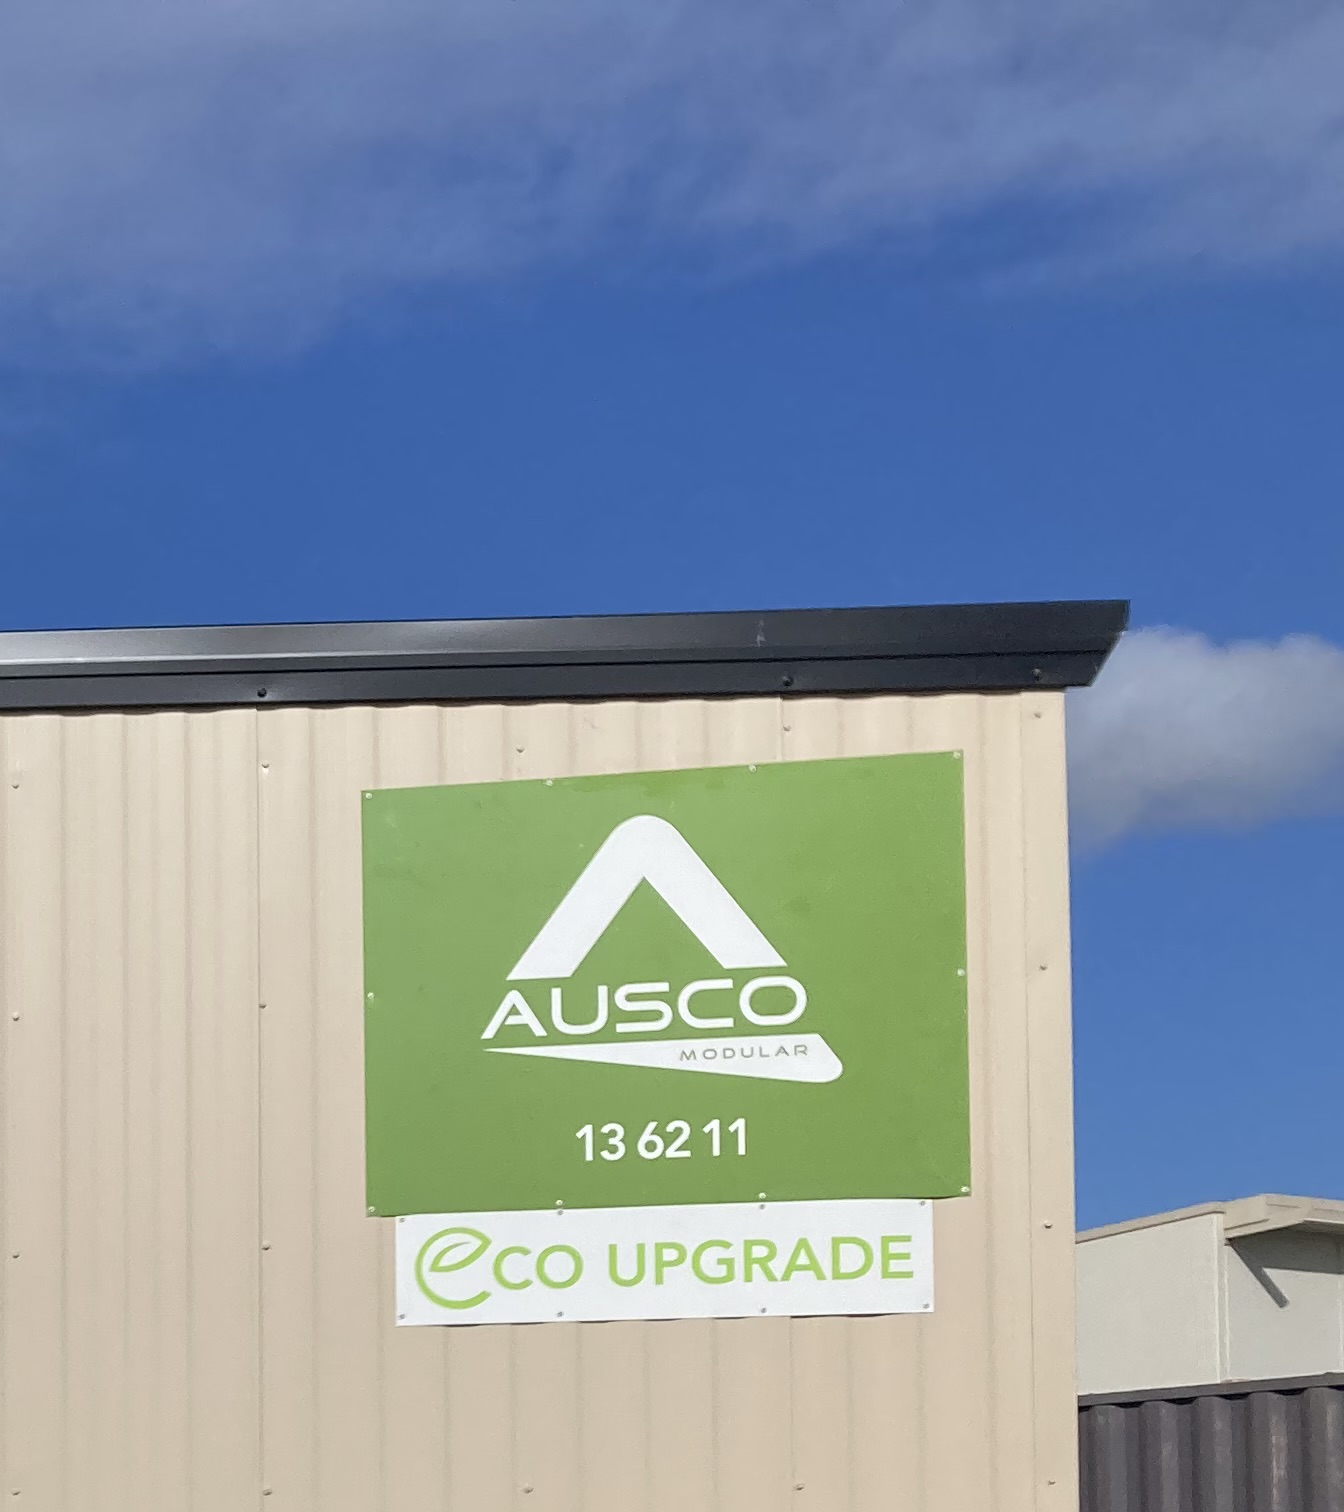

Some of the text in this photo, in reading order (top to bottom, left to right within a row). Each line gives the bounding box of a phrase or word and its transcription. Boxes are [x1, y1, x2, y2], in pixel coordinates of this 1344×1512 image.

[481, 975, 808, 1039] AUSCO
[679, 1044, 809, 1062] MODULAR
[575, 1117, 746, 1161] 13 62 11
[609, 1234, 915, 1287] UPGRADE
